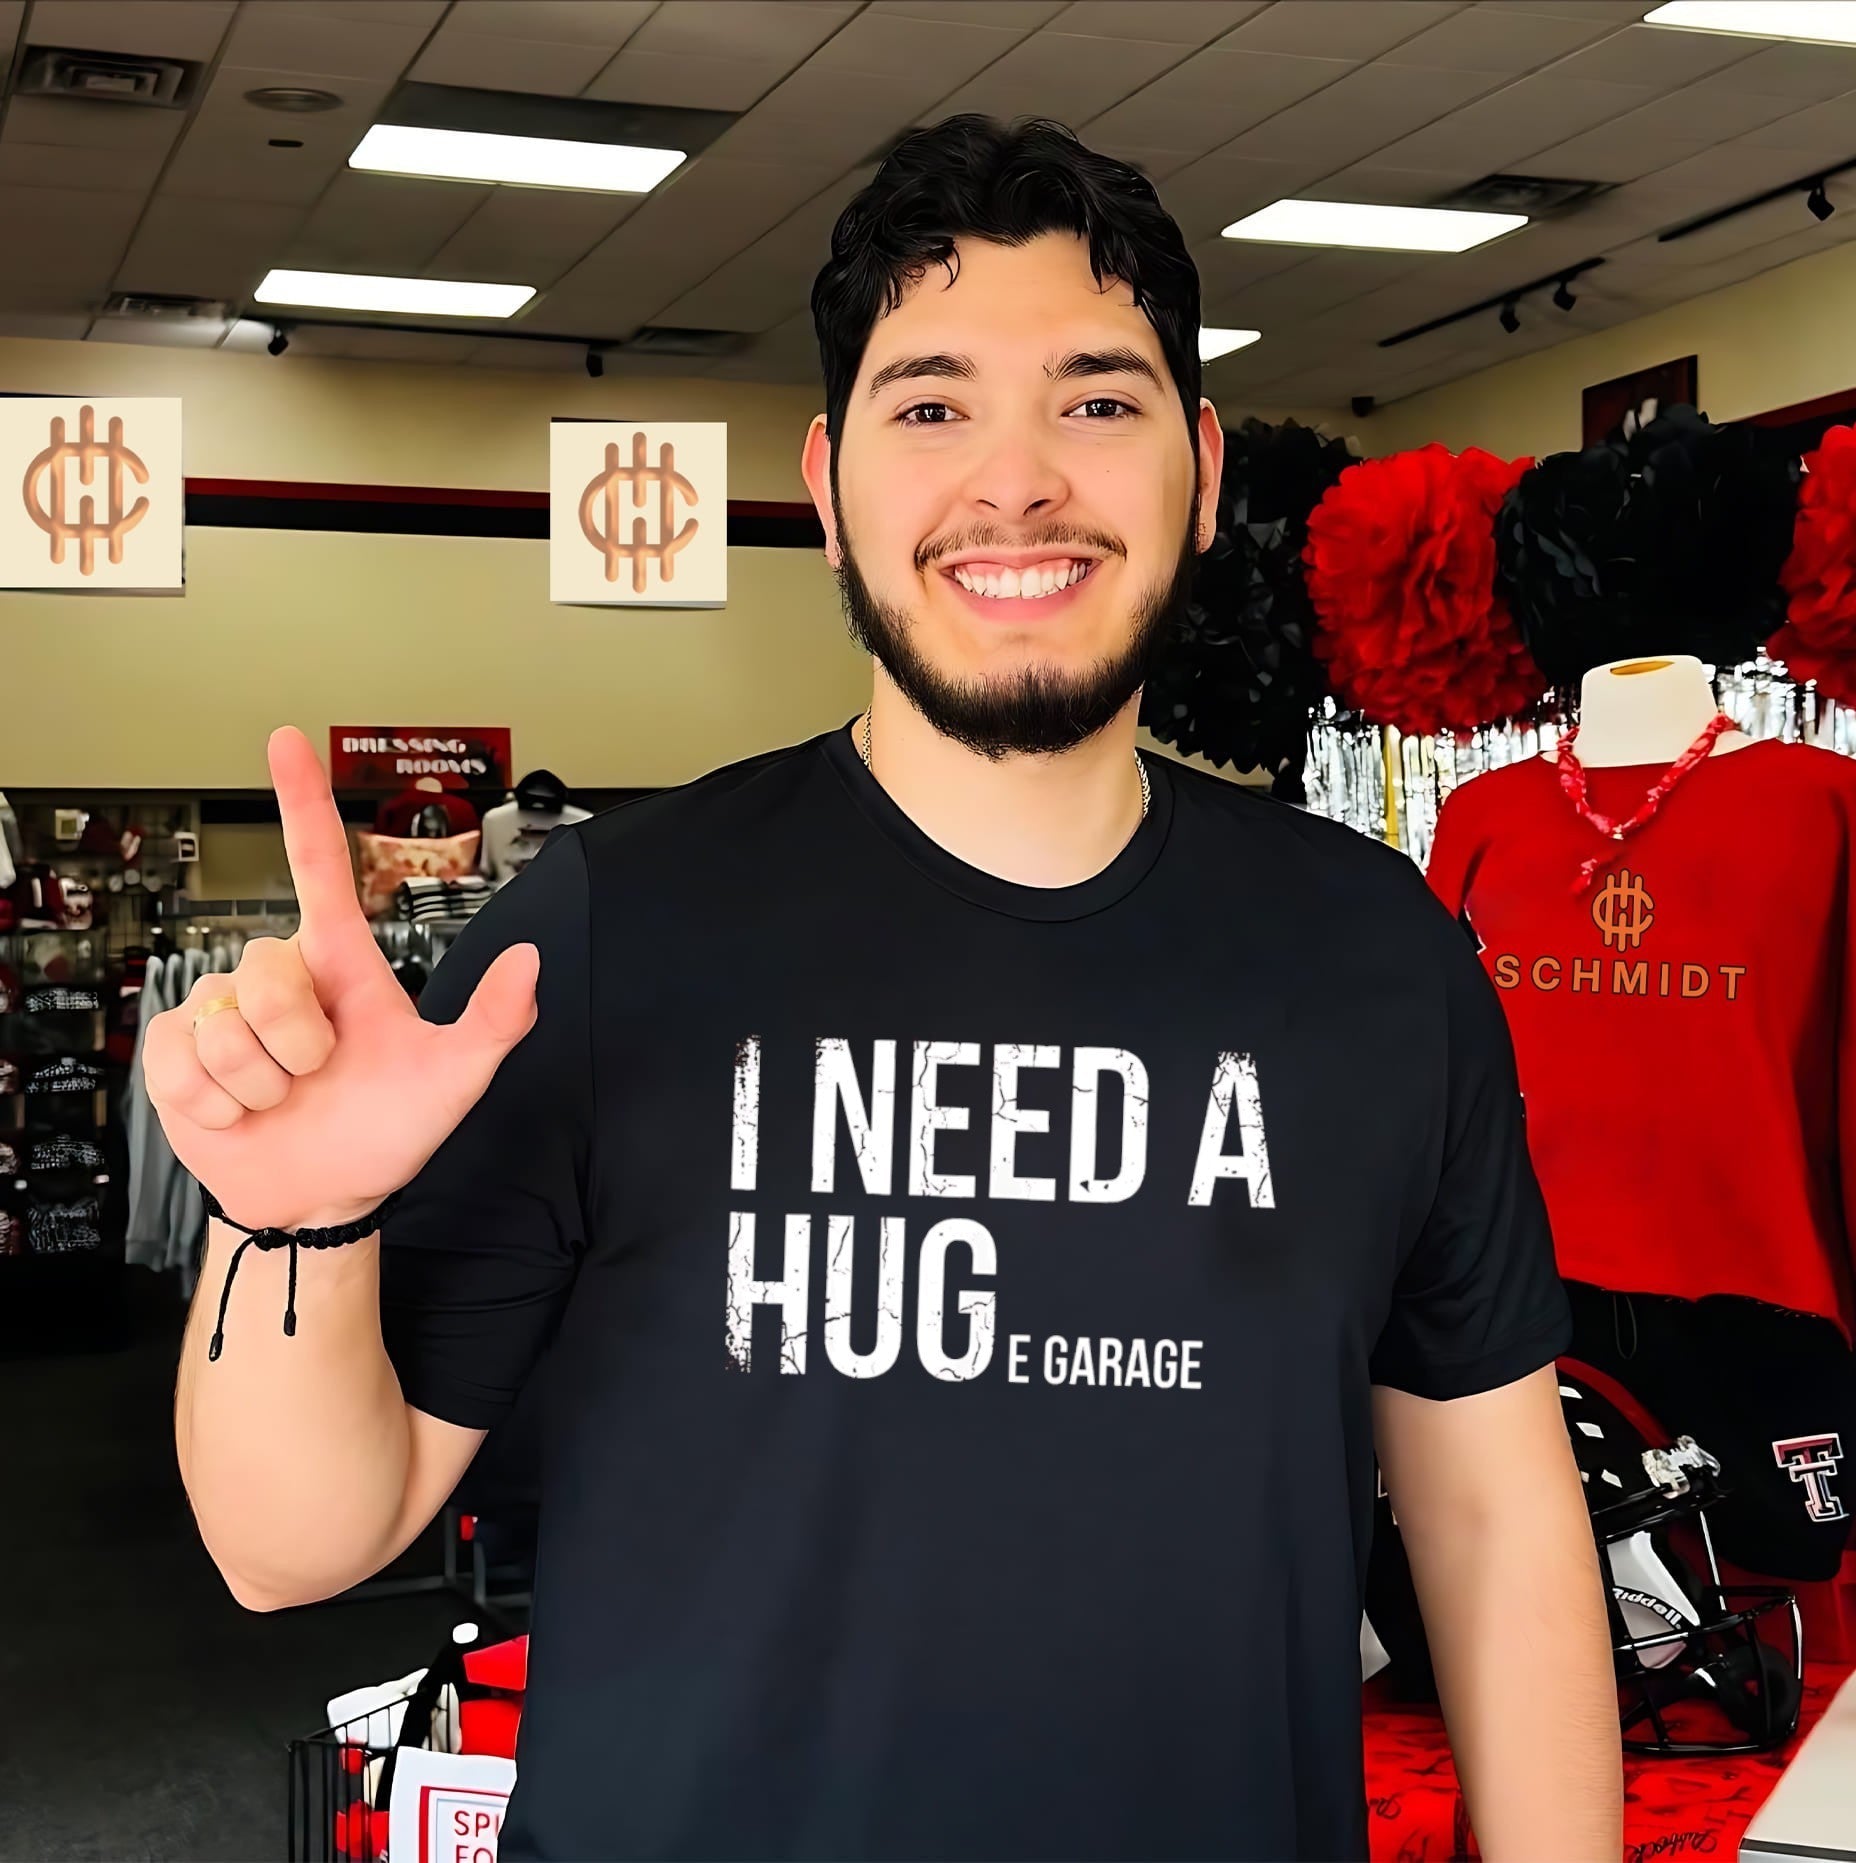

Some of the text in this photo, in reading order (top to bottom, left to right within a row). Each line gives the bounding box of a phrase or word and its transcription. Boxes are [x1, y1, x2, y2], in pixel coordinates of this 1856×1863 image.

[342, 737, 466, 754] DRESSING
[396, 758, 487, 775] ROOMS
[1494, 953, 1747, 1000] SCHMIDT
[730, 1034, 1276, 1209] I NEED A
[725, 1211, 1203, 1390] HUG E GARAGE
